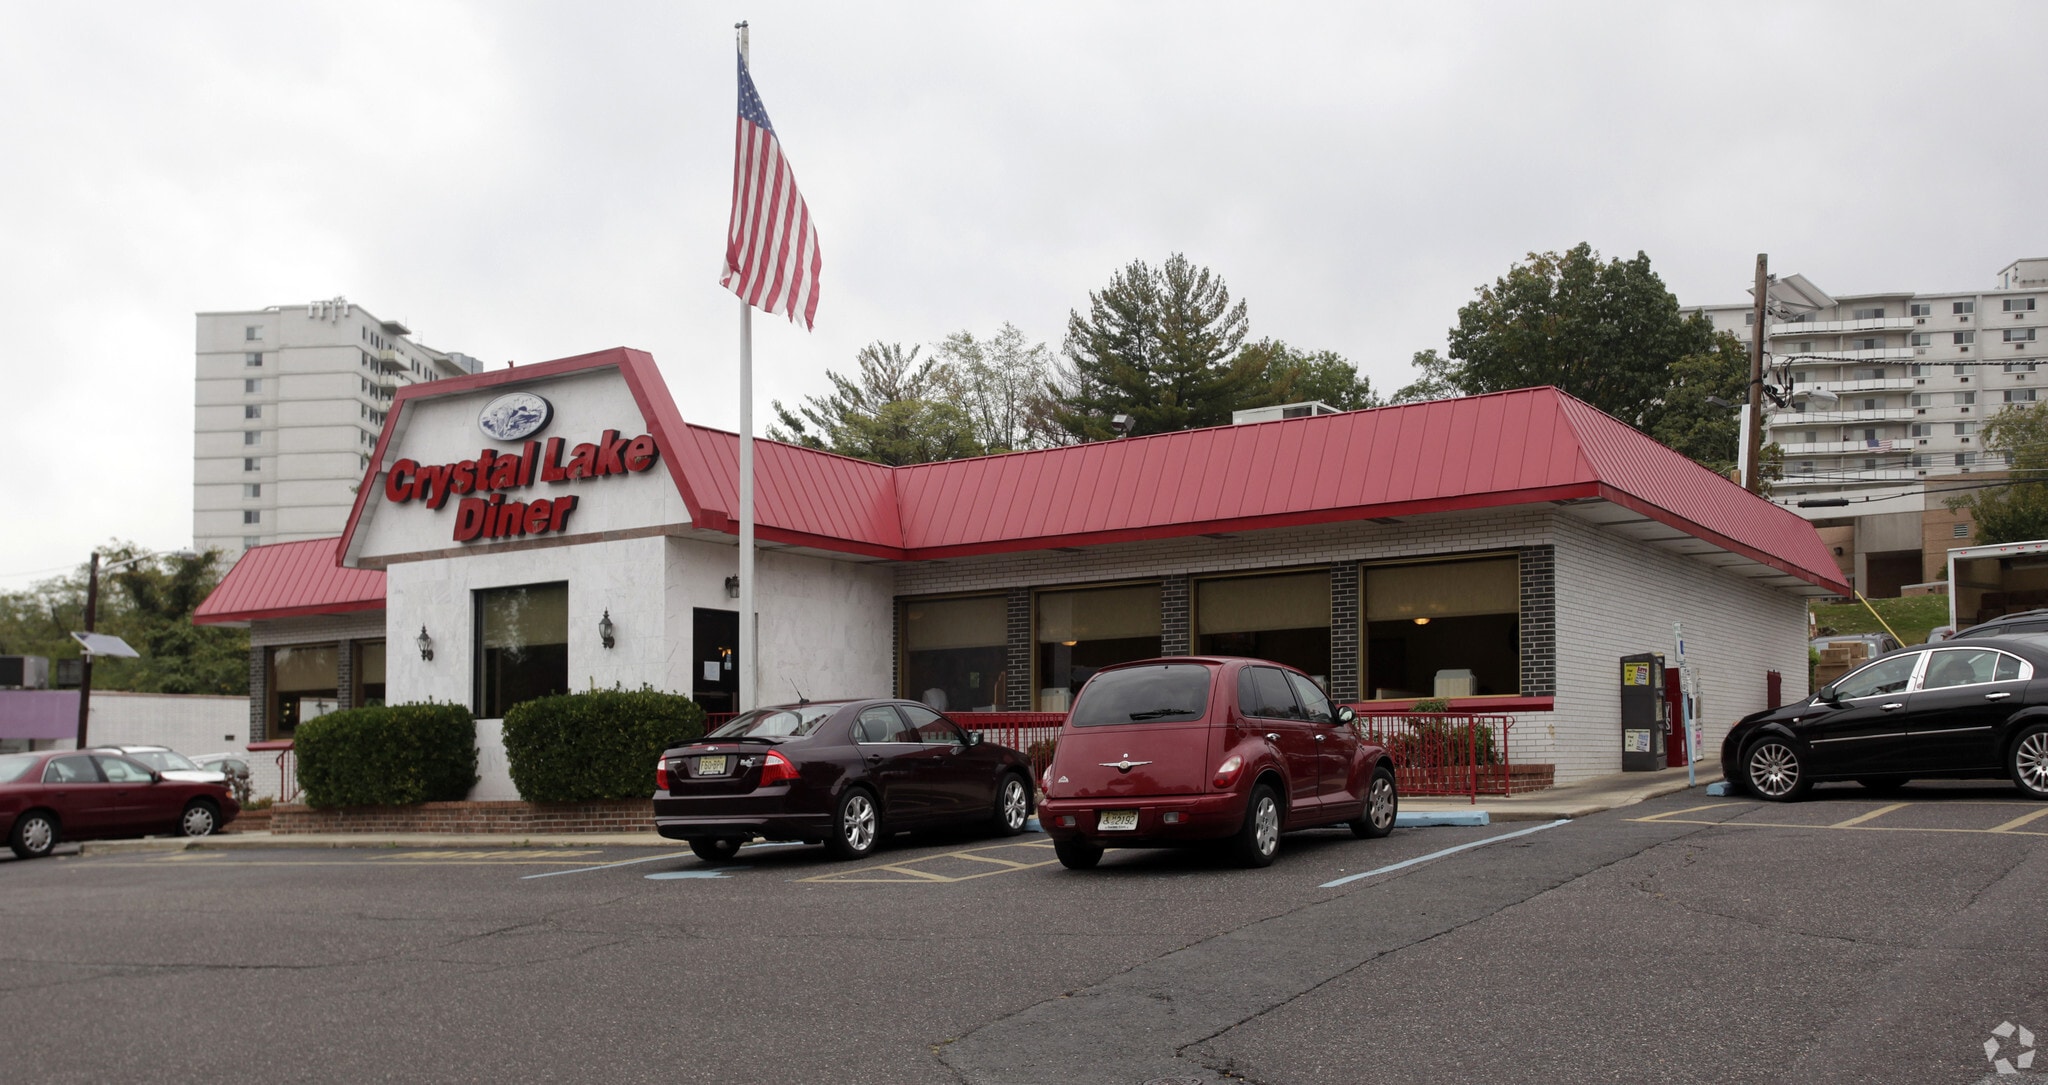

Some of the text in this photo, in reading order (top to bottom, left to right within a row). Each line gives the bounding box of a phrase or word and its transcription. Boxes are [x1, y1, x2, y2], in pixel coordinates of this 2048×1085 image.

[385, 429, 660, 509] Crystal Lake
[453, 493, 579, 542] Diner
